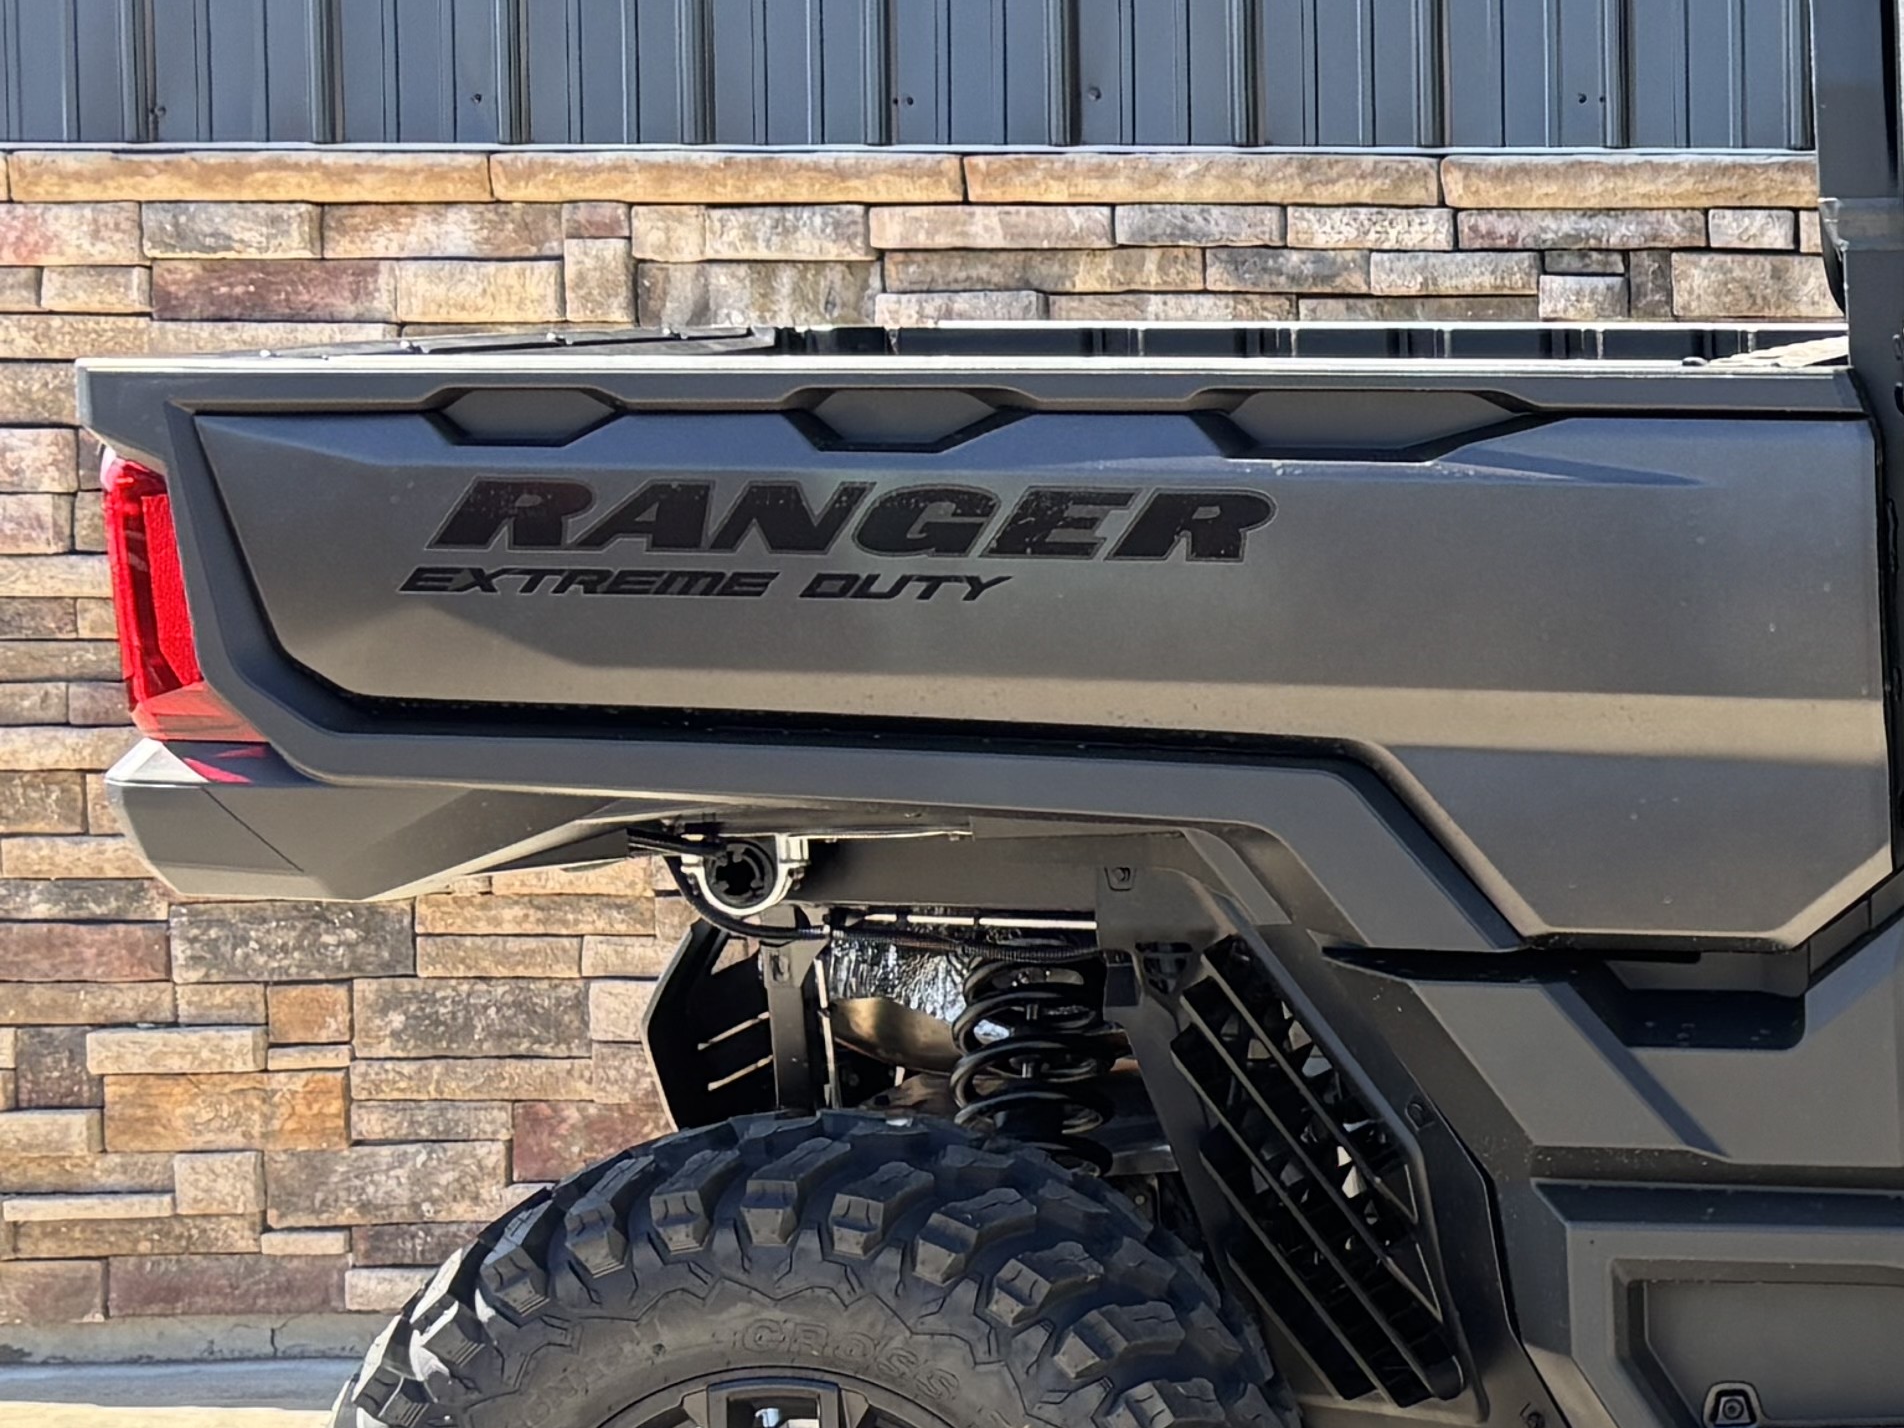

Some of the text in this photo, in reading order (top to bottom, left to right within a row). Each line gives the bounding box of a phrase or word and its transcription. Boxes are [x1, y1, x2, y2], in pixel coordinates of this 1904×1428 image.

[424, 476, 1277, 562] RANGER
[398, 566, 1012, 601] EXTREME DUTY
[743, 1319, 958, 1400] CROSS
